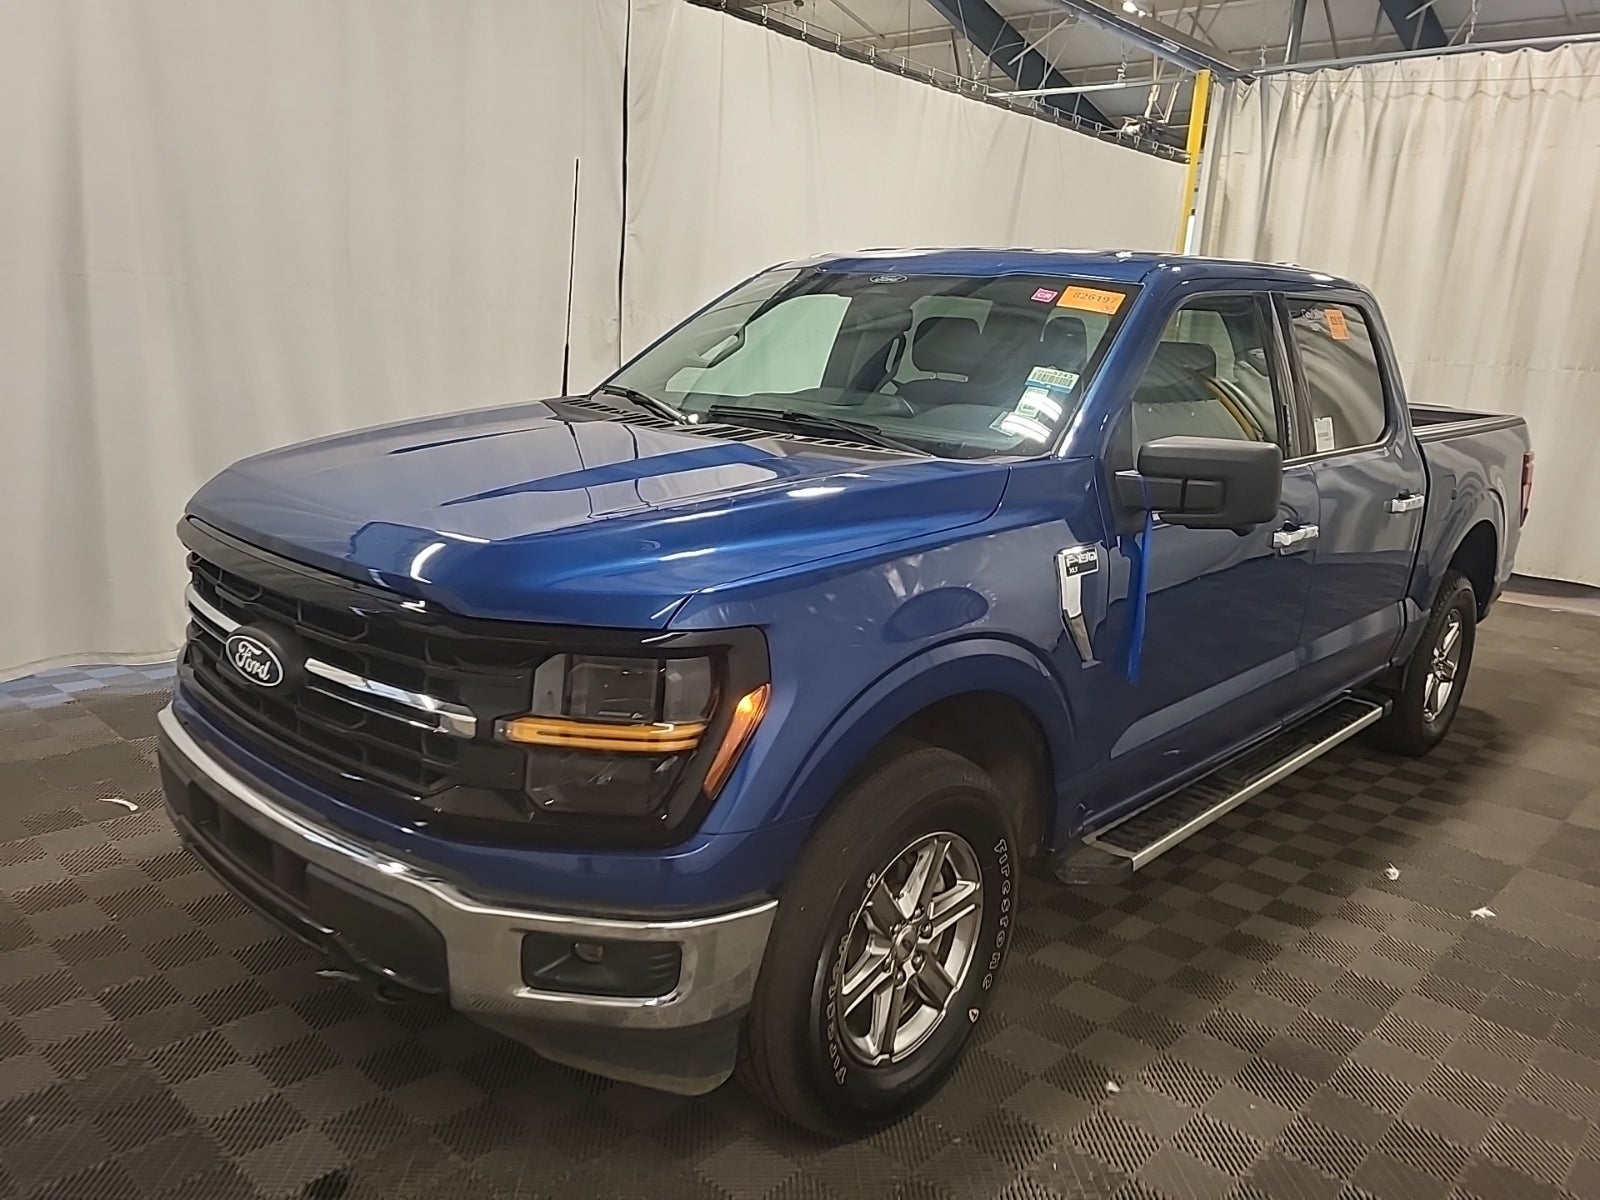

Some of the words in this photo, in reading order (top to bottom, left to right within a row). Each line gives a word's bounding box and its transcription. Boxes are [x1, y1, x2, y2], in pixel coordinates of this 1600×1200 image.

[1072, 291, 1118, 304] 826197
[235, 641, 271, 681] Ford
[983, 838, 1011, 991] Firestone
